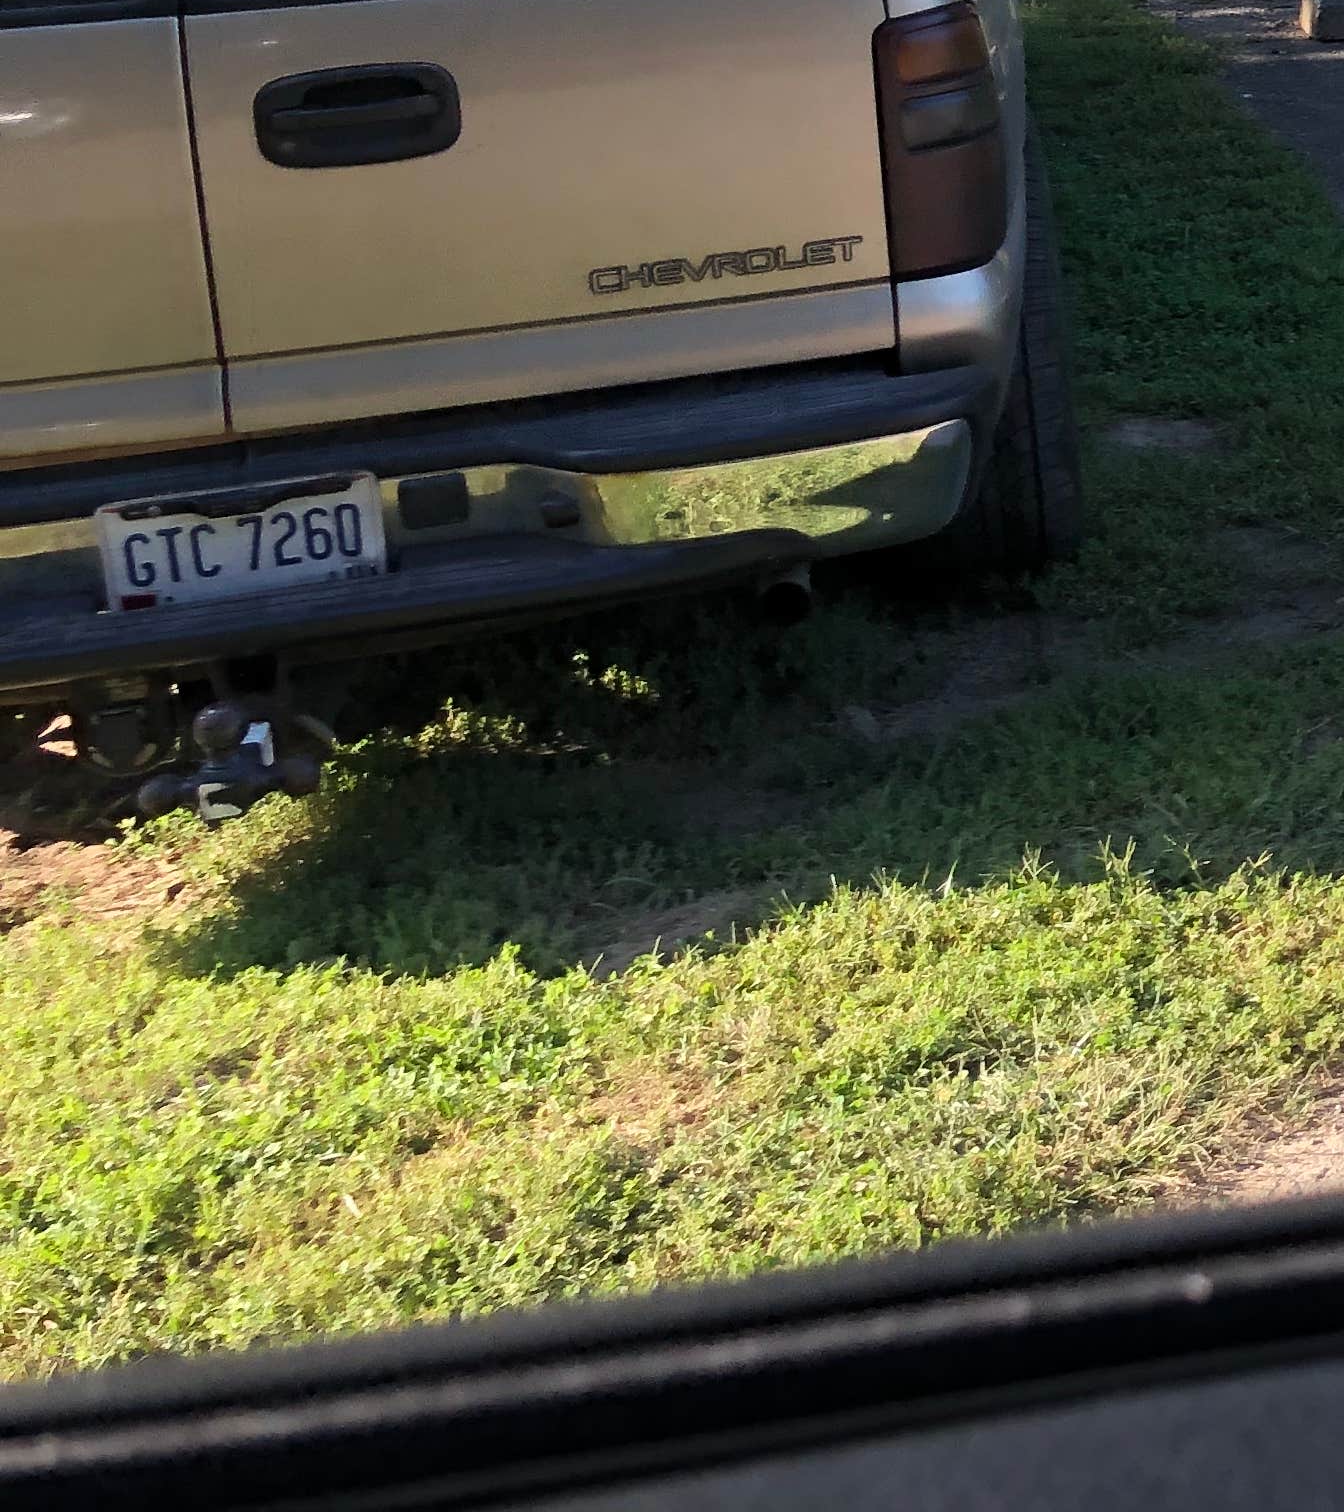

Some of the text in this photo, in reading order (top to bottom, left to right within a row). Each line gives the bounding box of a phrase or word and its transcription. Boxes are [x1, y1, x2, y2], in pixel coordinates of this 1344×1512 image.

[589, 235, 863, 294] CHEVROLET
[124, 502, 363, 587] GTC 7260
